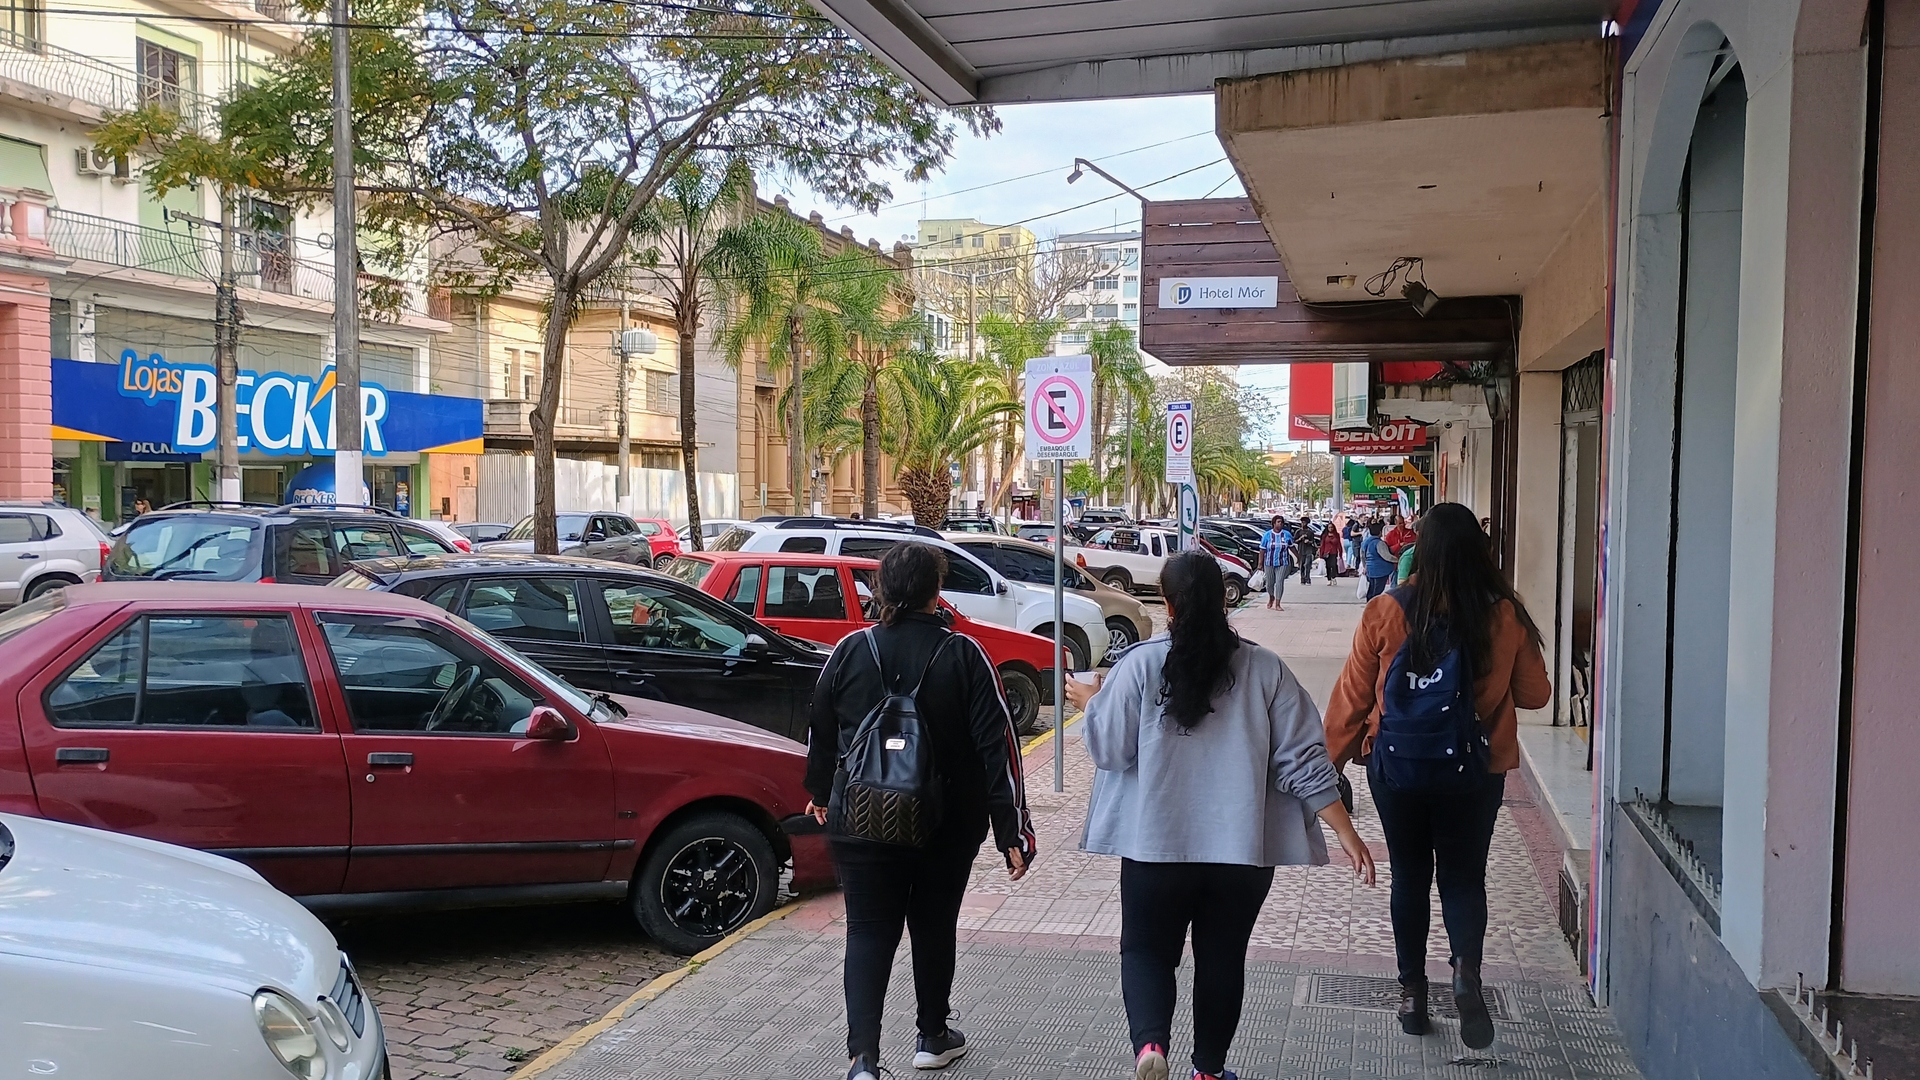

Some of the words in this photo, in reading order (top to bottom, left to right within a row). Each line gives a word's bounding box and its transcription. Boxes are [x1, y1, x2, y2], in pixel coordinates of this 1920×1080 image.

[1200, 287, 1233, 299] Hotel
[1238, 287, 1265, 298] Mór
[123, 356, 182, 398] Lojas
[1060, 361, 1079, 370] AZUL
[1048, 390, 1067, 430] E
[1176, 421, 1183, 444] E
